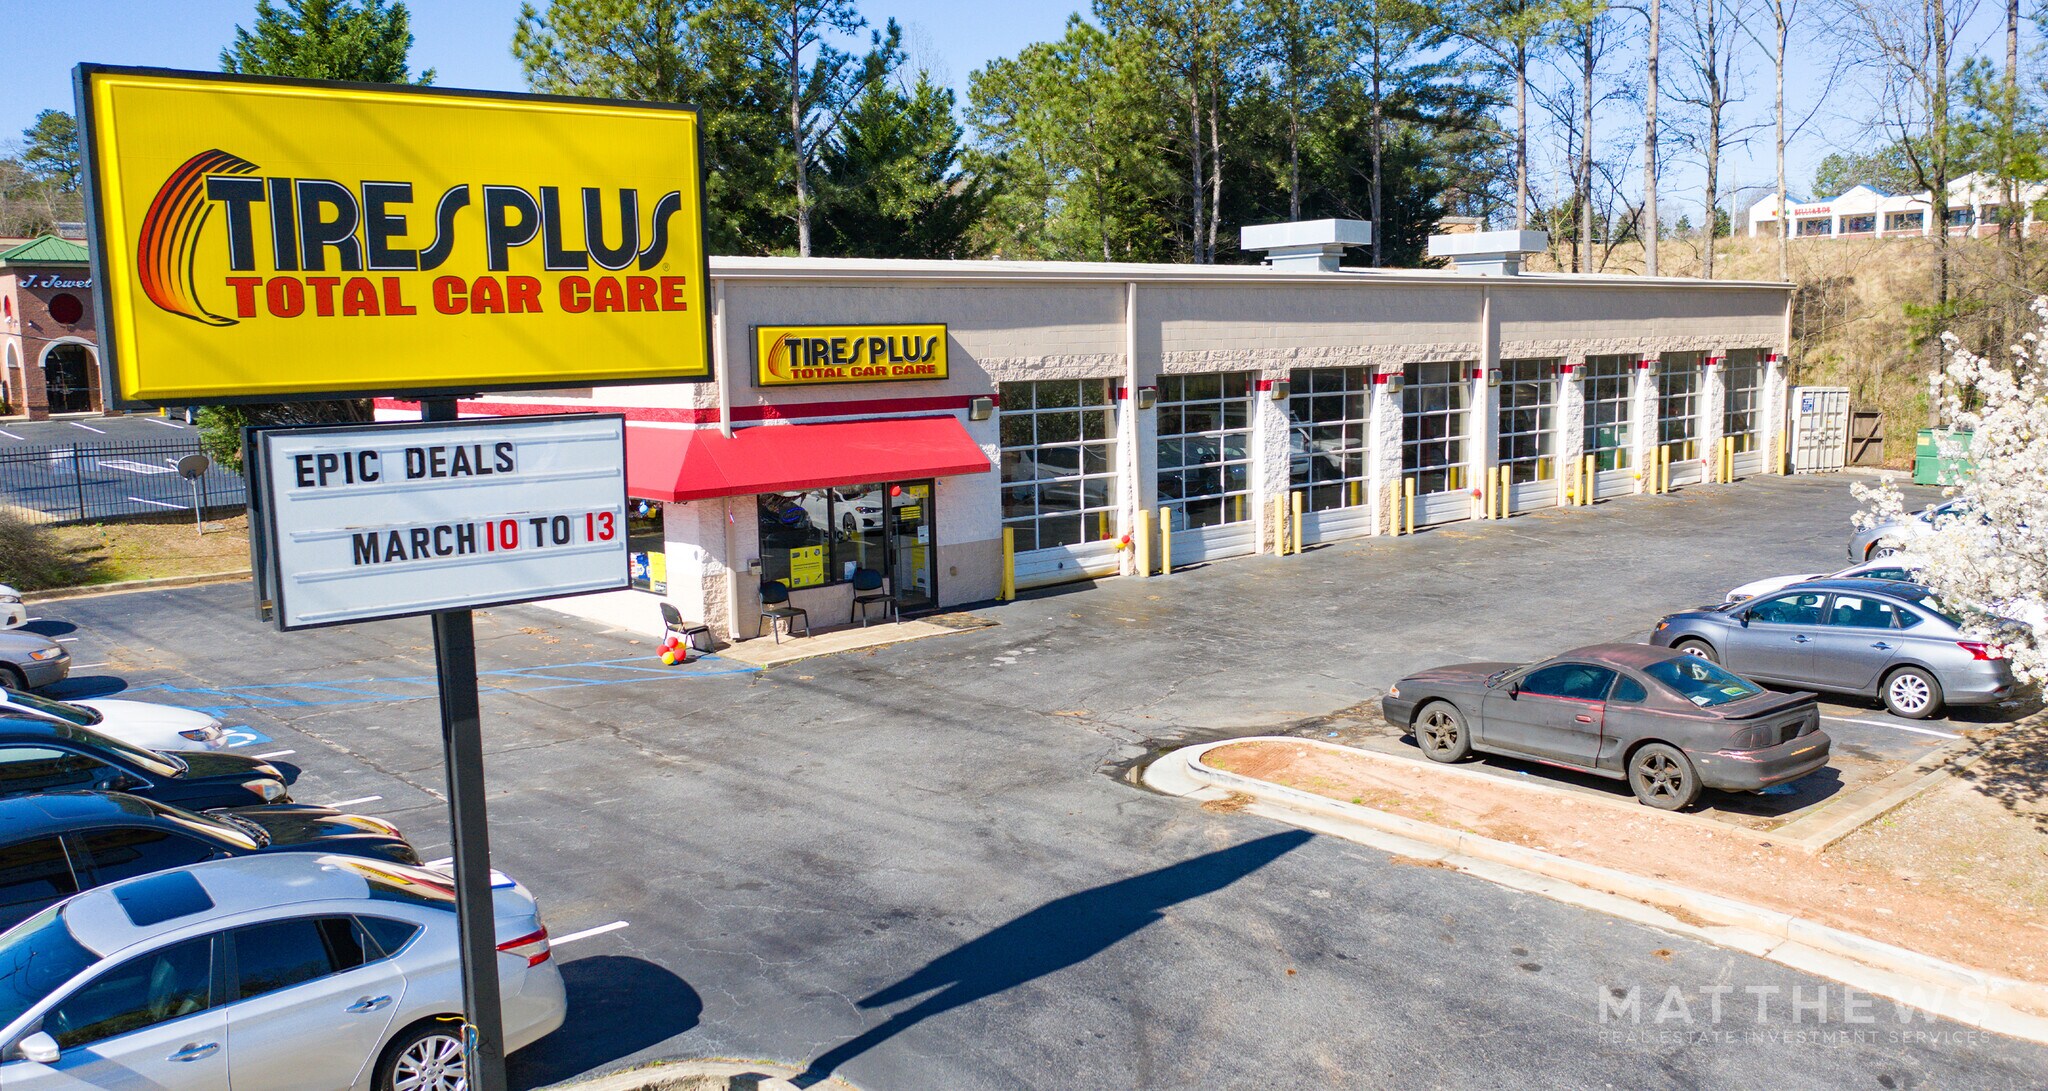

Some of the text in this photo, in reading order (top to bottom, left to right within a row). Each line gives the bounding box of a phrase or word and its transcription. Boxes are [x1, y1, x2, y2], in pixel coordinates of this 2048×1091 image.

[205, 174, 682, 272] TIRES PLUS
[19, 274, 38, 288] J.
[226, 275, 688, 318] TOTAL CAR CARE
[784, 335, 938, 367] TIRES PLUS
[790, 364, 936, 379] TOTAL CAR CARE
[295, 442, 514, 488] EPIC DEALS
[352, 511, 615, 566] MARCH 10 TO 13
